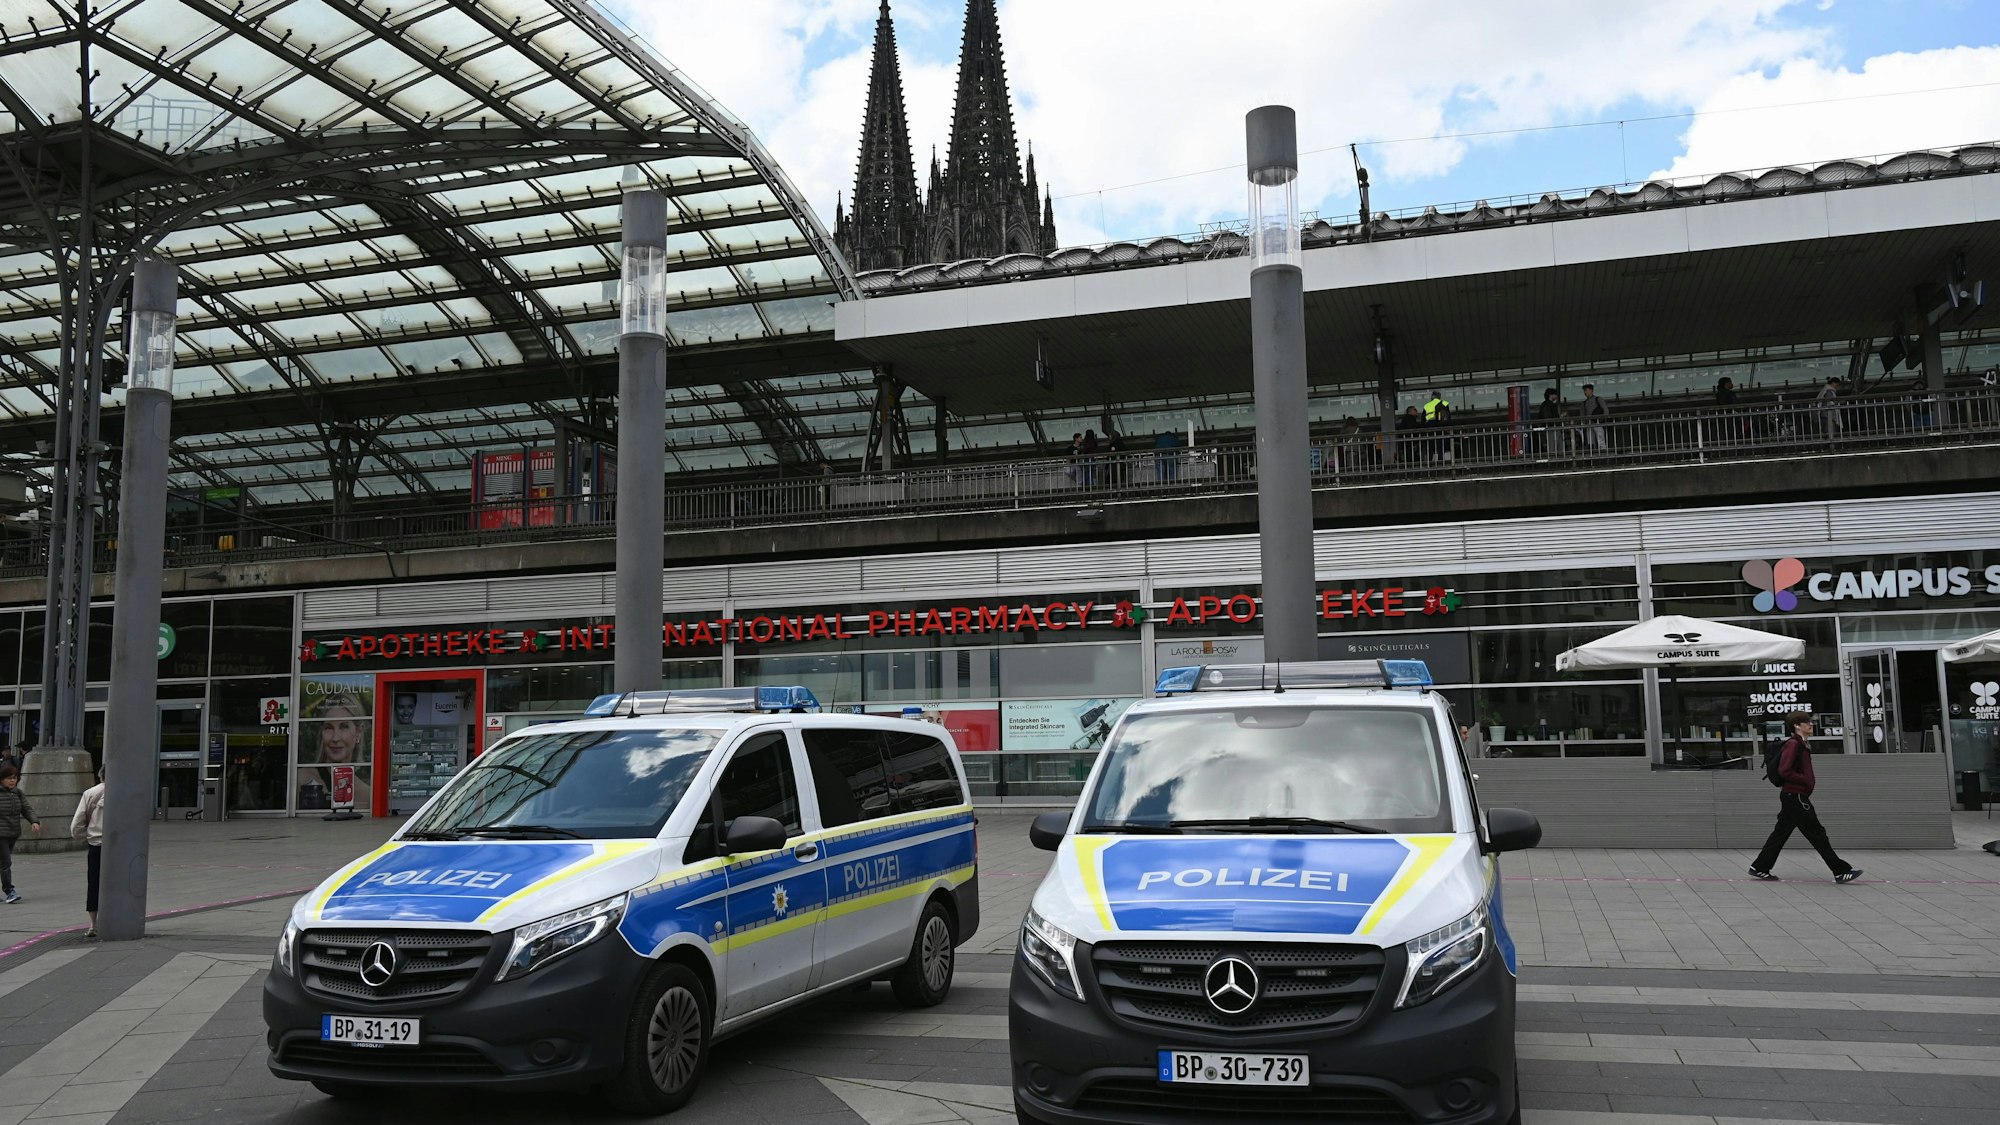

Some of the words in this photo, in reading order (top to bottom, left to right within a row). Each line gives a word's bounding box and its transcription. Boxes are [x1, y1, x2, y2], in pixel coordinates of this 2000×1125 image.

[1808, 566, 1971, 601] CAMPUS
[1166, 587, 1406, 625] APOEKE
[560, 612, 852, 651] INTNATIONAL
[868, 601, 1095, 637] PHARMACY
[337, 629, 505, 661] APOTHEKE
[1171, 648, 1181, 656] LA
[1657, 650, 1693, 659] CAMPUS
[1695, 650, 1720, 658] SUITE
[1763, 663, 1796, 674] JUICE
[1768, 682, 1808, 692] LUNCH
[435, 702, 458, 710] Eucerin
[1749, 693, 1798, 703] SNACKS
[1747, 705, 1765, 715] and
[1766, 703, 1812, 714] COFFEE
[1969, 706, 2000, 714] CAMPU
[356, 869, 513, 890] POLIZEI
[844, 855, 900, 892] POLIZEI
[1137, 868, 1349, 892] POLIZEI
[335, 1019, 354, 1038] BP
[364, 1020, 411, 1041] 31-19
[1176, 1055, 1202, 1079] BP
[1220, 1057, 1303, 1082] 30-739
